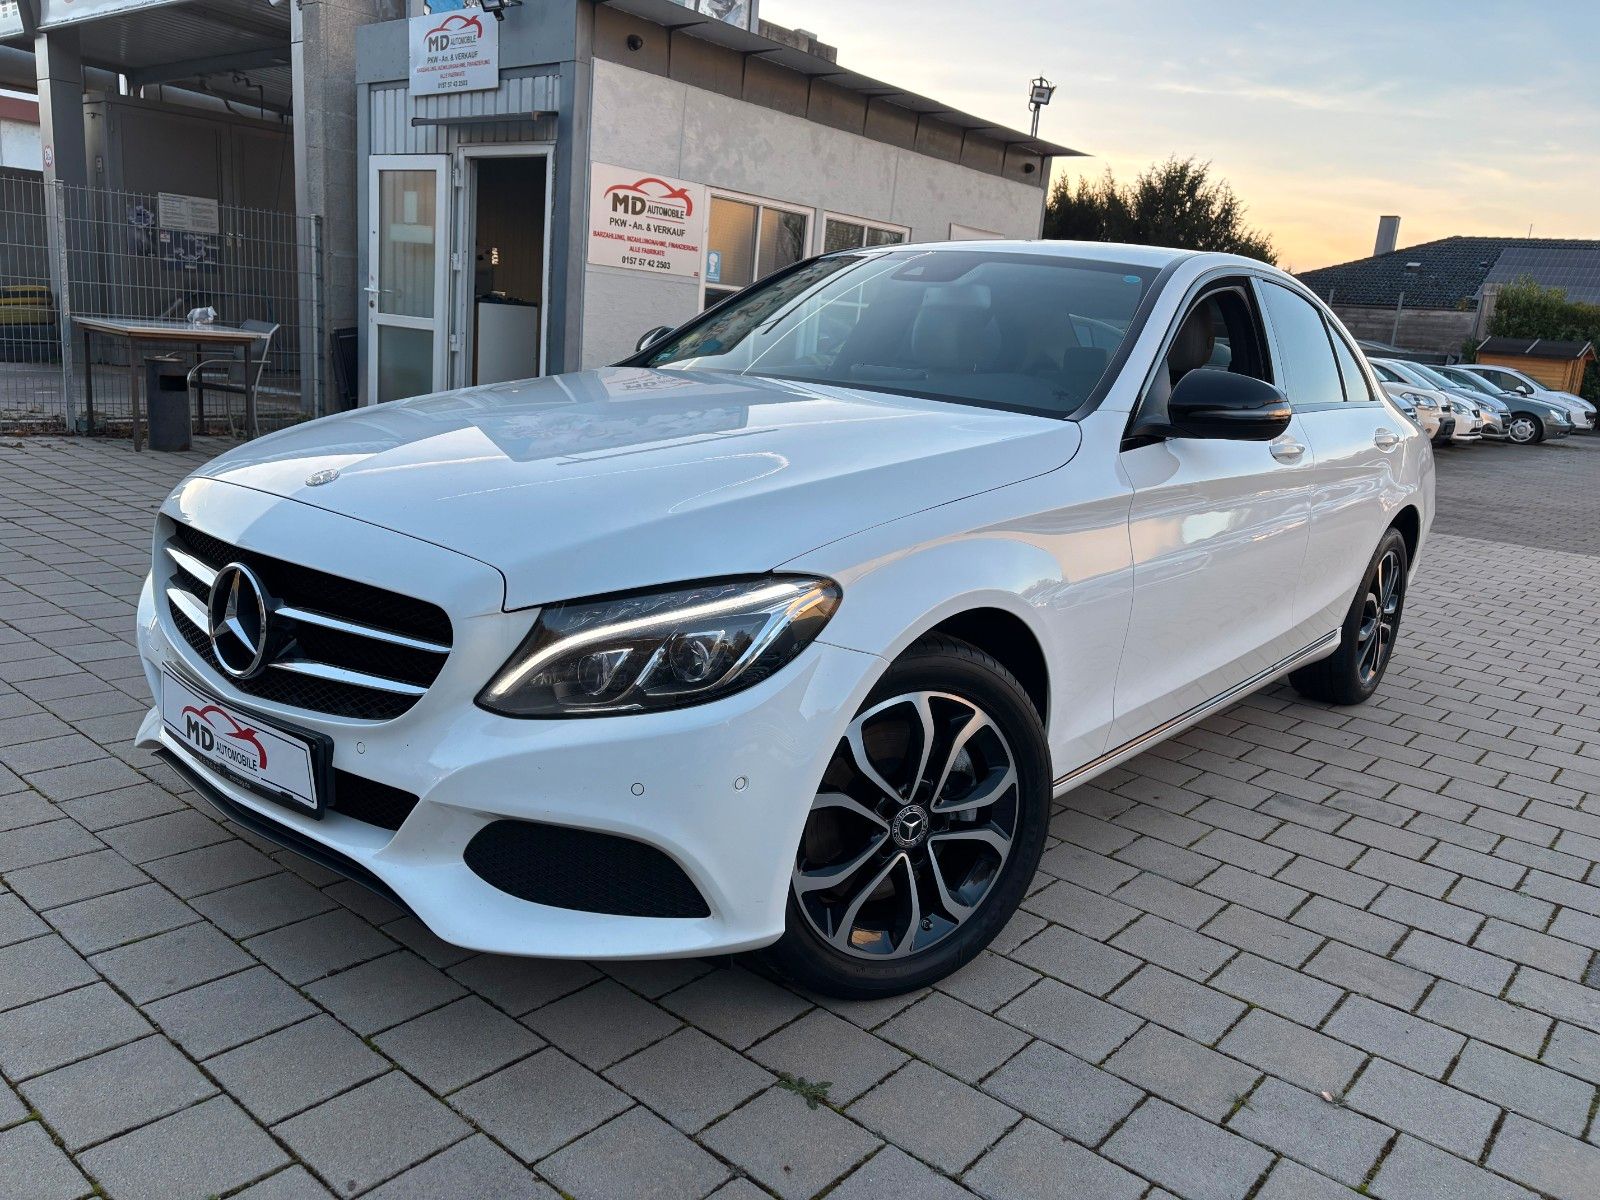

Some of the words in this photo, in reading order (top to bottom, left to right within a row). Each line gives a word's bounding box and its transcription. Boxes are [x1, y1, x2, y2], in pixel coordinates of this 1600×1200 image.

[428, 35, 449, 52] MD
[450, 35, 477, 46] AUTOMOBILE
[427, 56, 438, 64] PKW
[454, 51, 478, 60] VERKAUF
[611, 192, 646, 215] MD
[647, 205, 685, 219] AUTOMOBILE
[609, 217, 627, 228] PKW
[632, 221, 645, 231] An.
[646, 223, 651, 232] &
[653, 224, 686, 237] VERKAUF
[621, 256, 637, 265] 0157
[638, 258, 647, 266] 57
[647, 259, 655, 267] 42
[656, 260, 671, 269] 2503
[186, 714, 215, 751] MD
[216, 741, 258, 772] AUTOMOBILE
